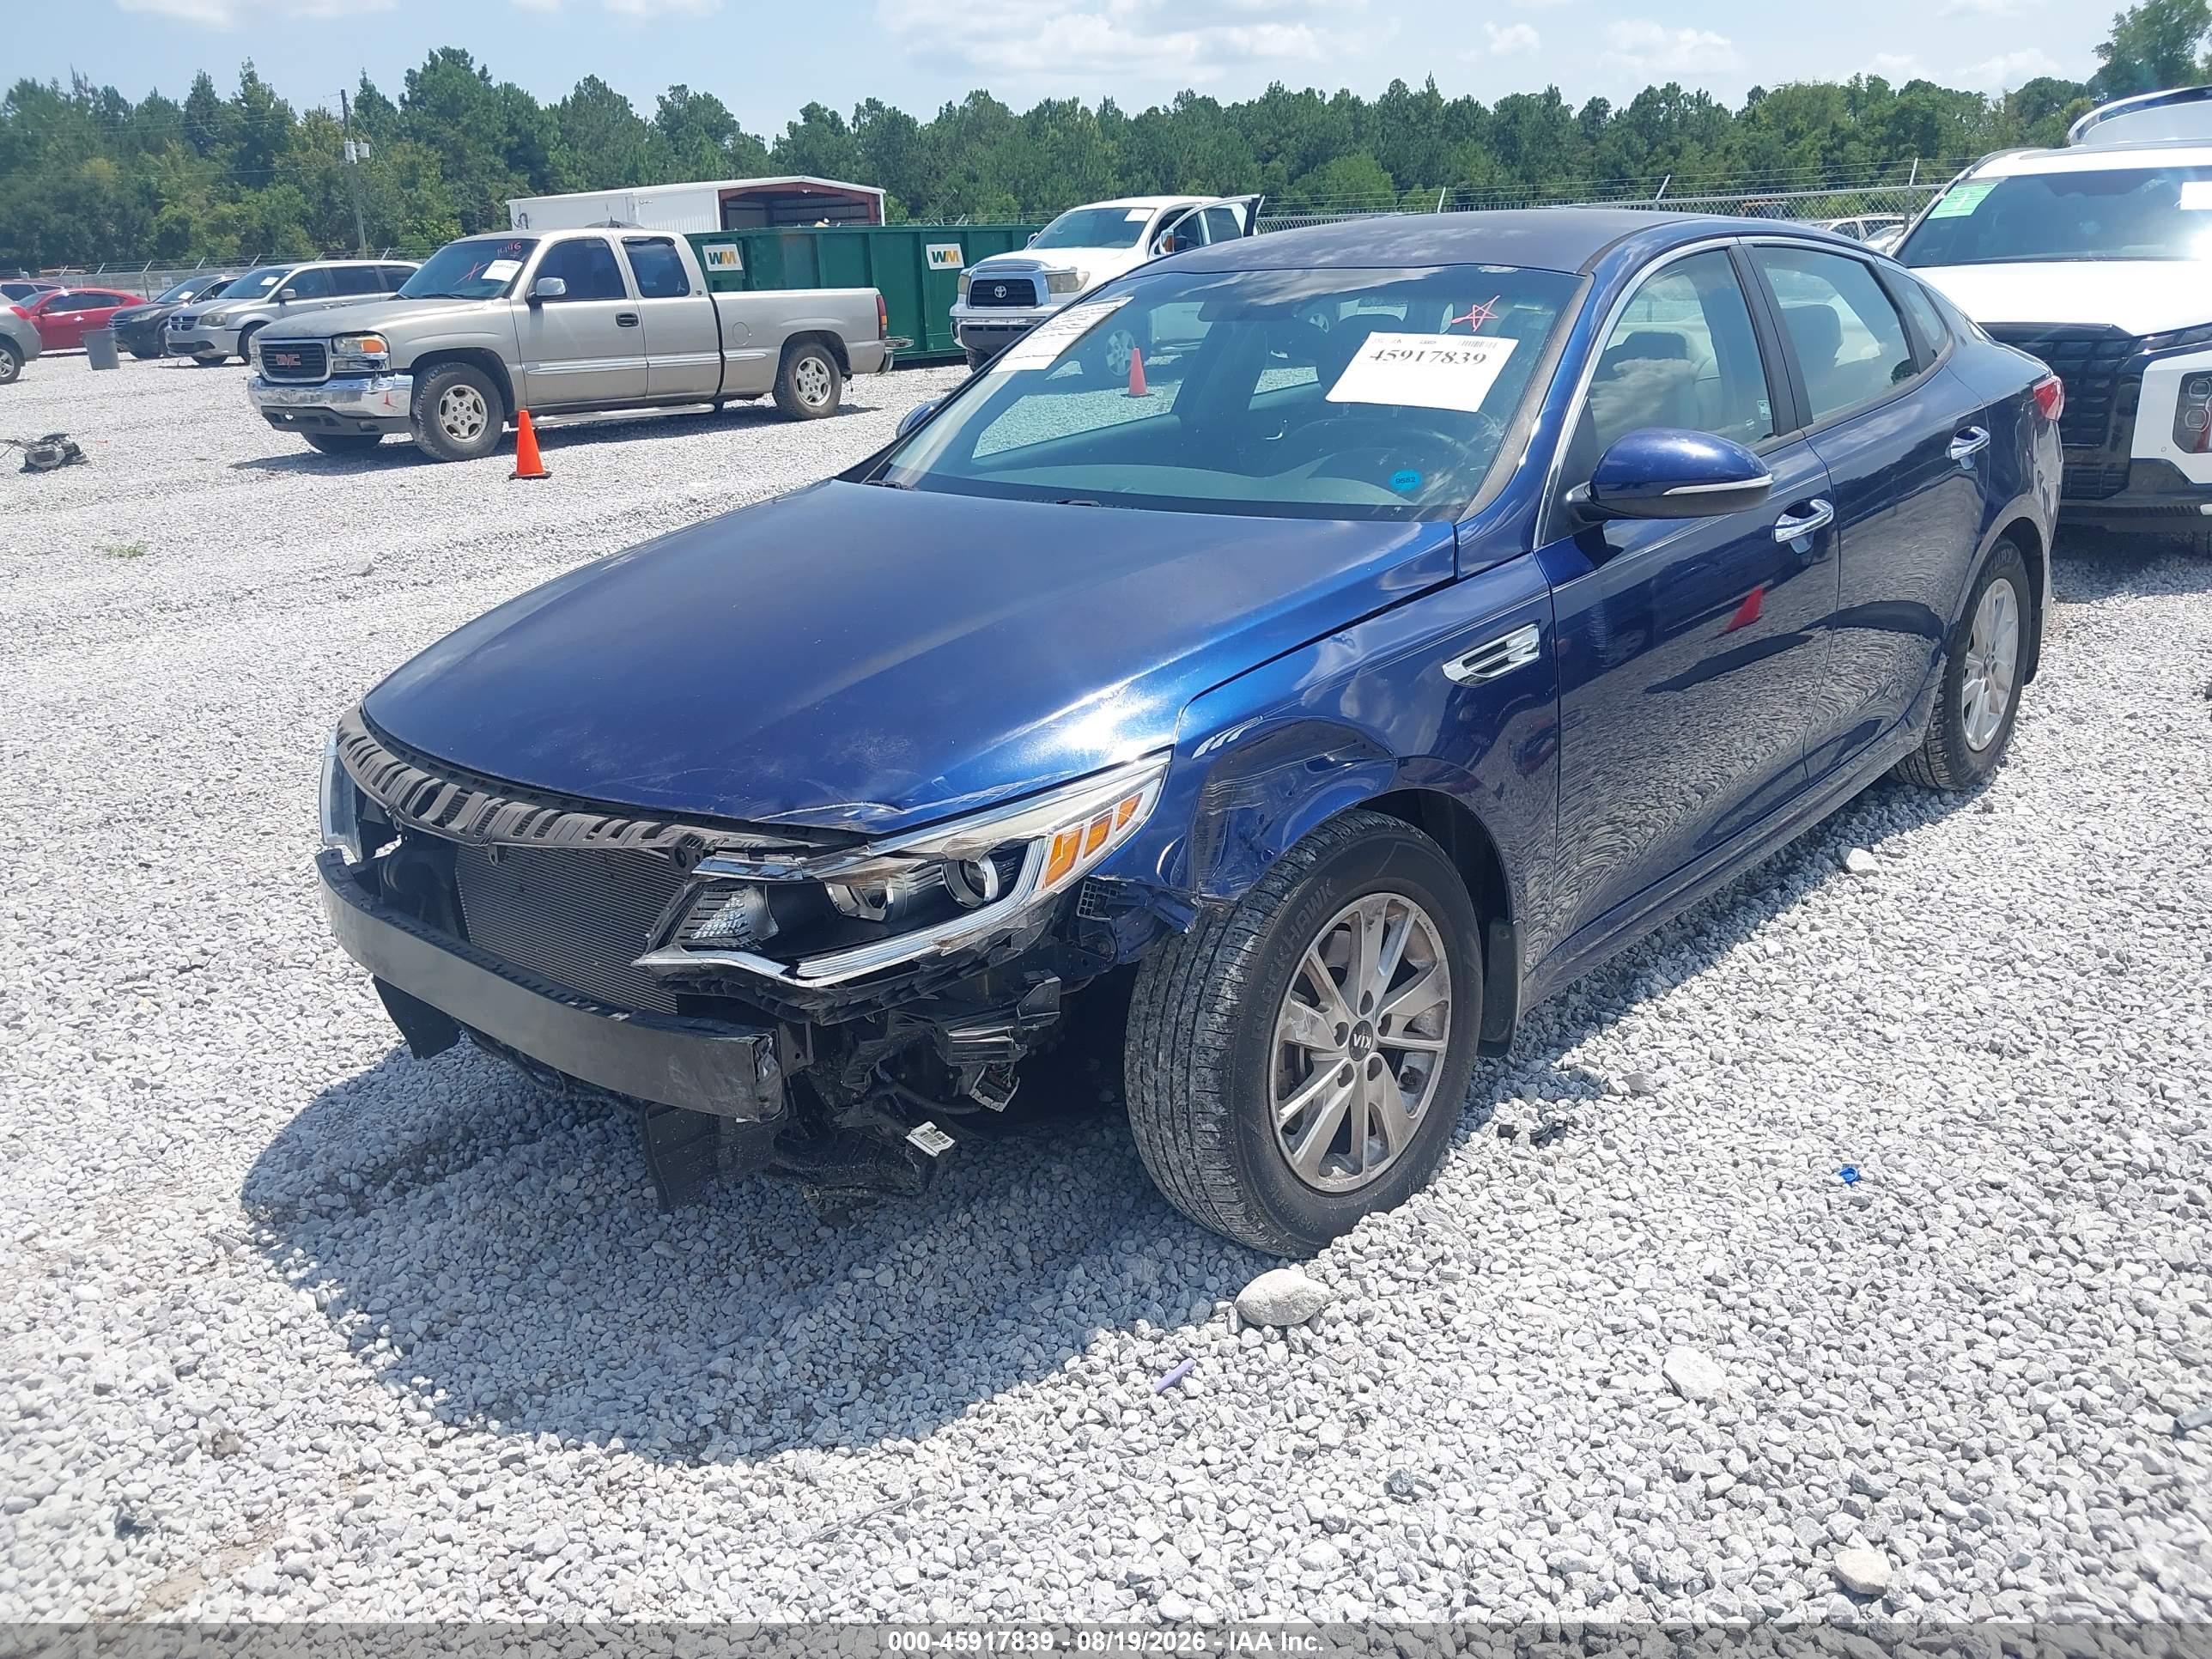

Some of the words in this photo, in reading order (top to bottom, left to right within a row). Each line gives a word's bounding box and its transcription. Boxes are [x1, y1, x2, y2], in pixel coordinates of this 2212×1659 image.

[708, 251, 738, 265] WM
[931, 250, 960, 264] WM
[1369, 349, 1488, 366] 45917839
[1353, 1032, 1372, 1049] KIA
